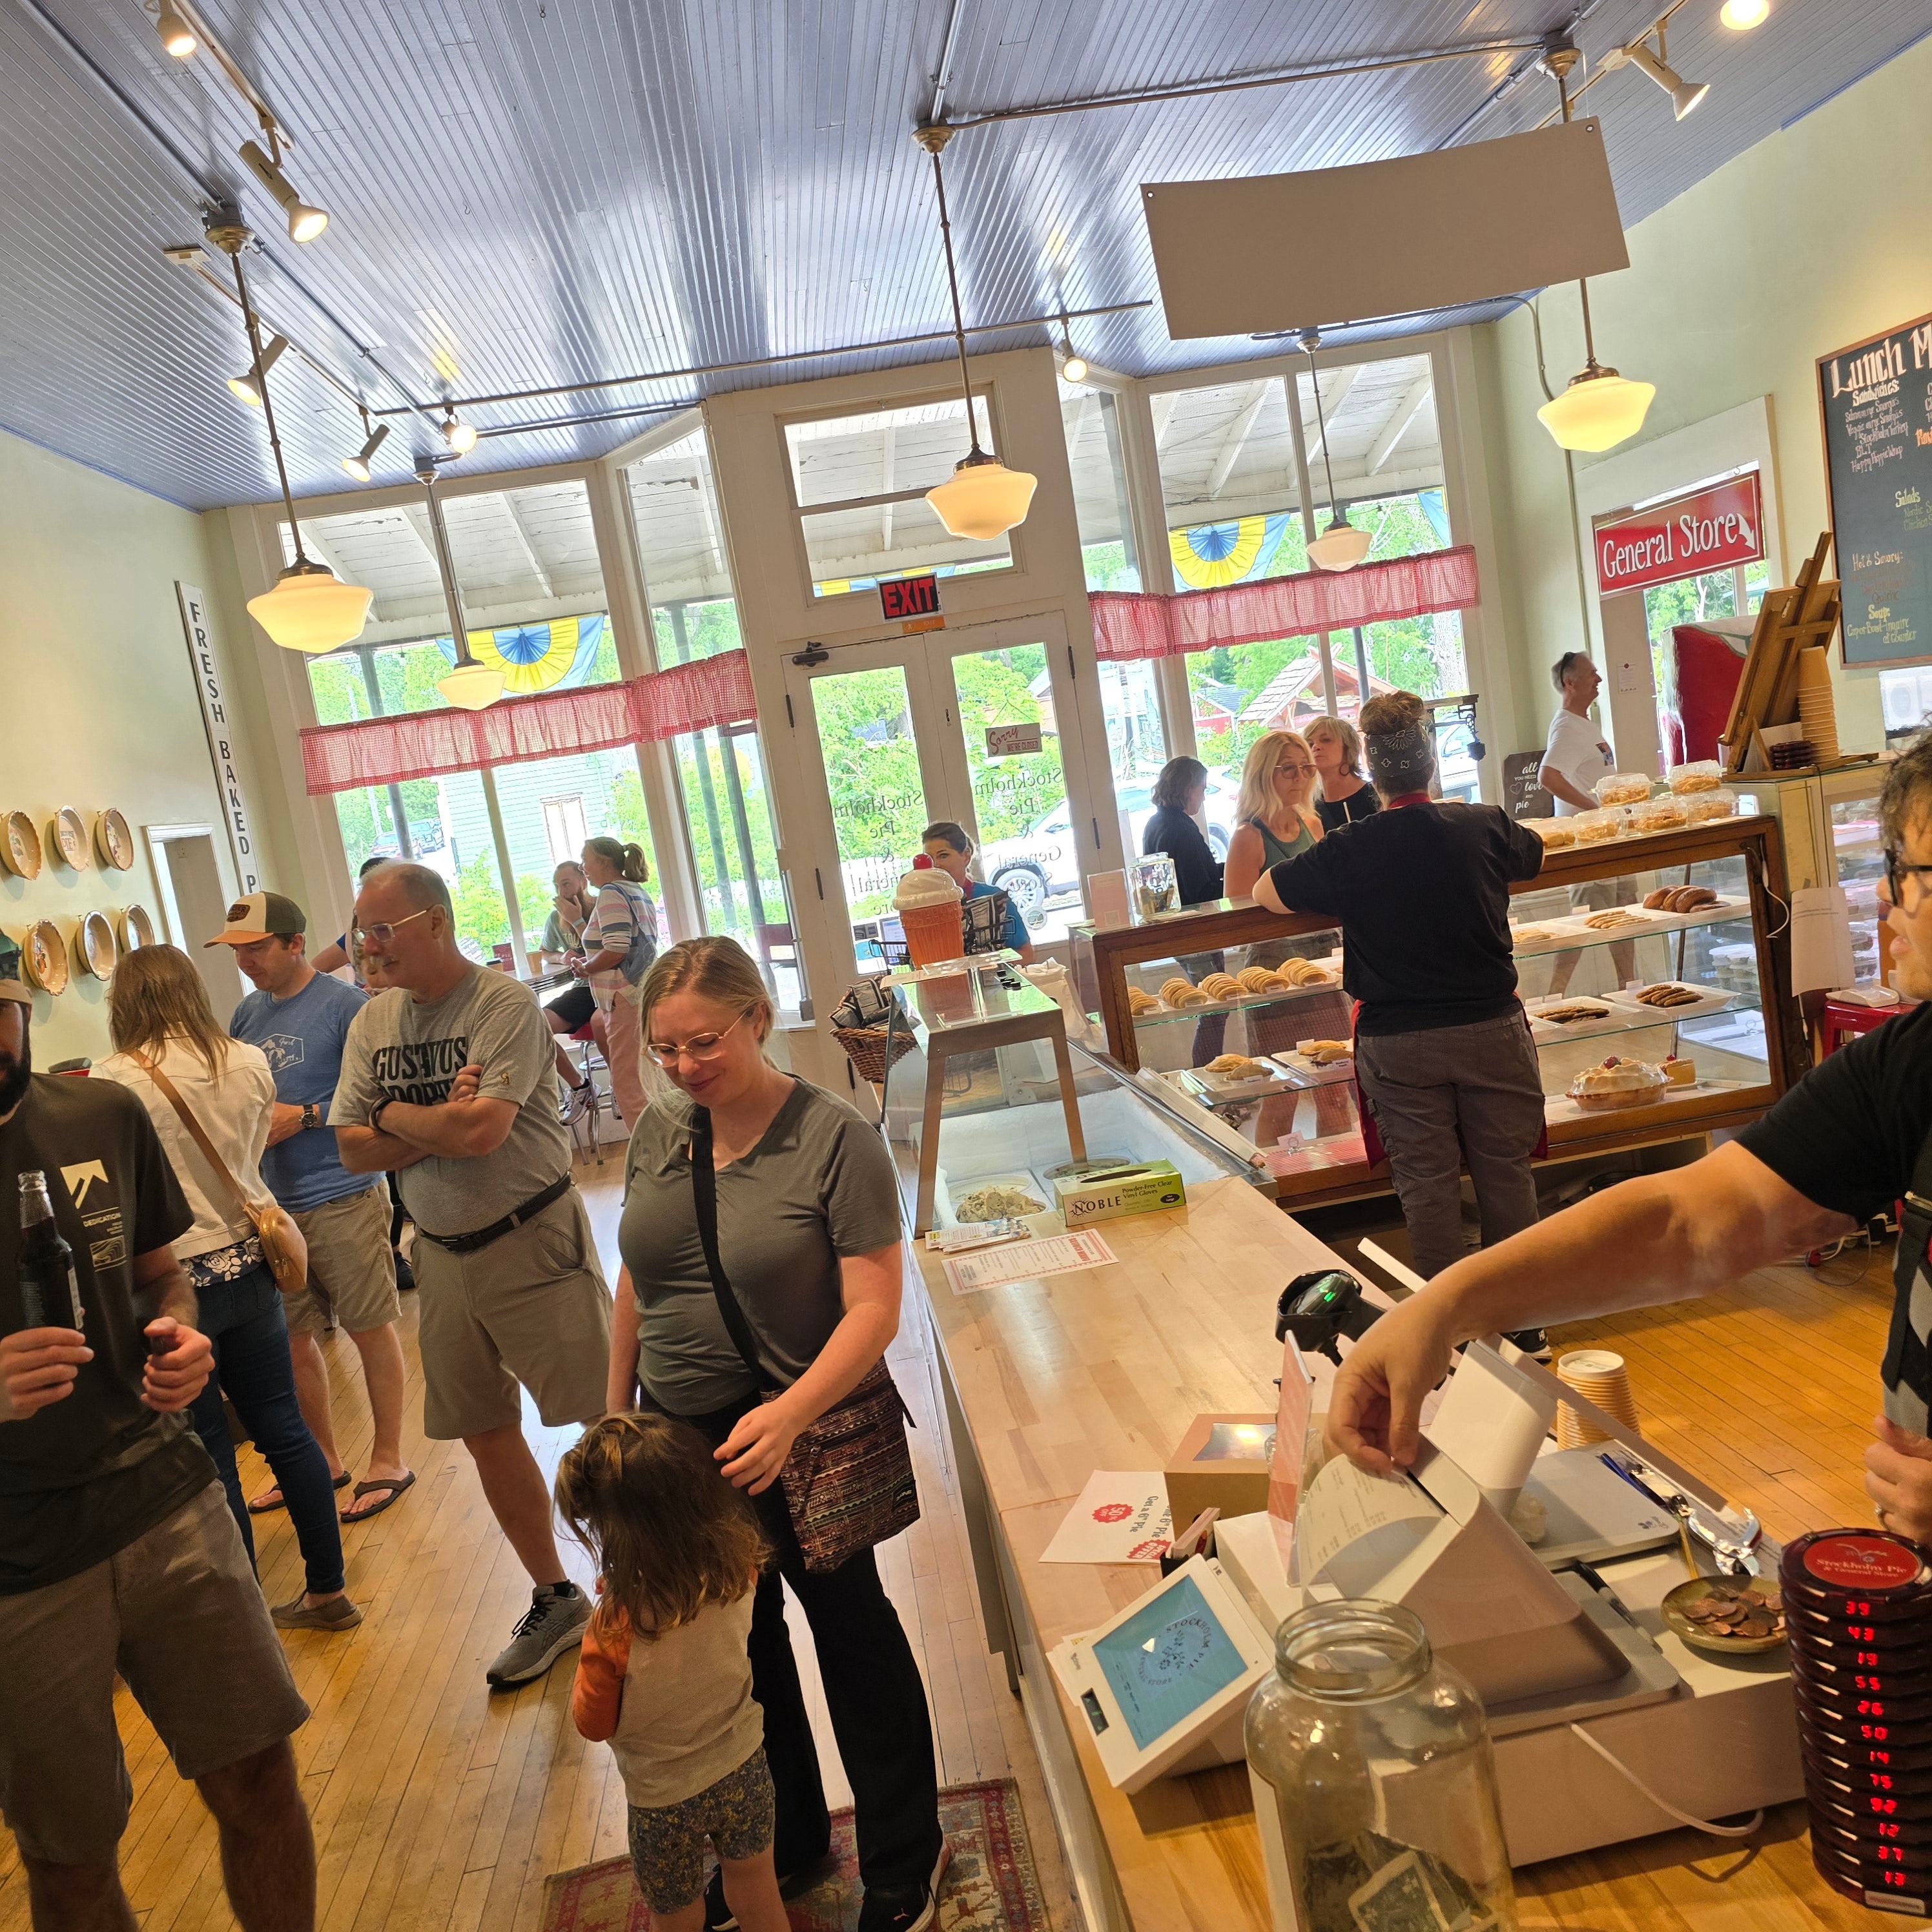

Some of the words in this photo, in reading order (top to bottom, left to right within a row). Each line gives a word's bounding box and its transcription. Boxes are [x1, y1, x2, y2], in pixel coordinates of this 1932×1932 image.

[1829, 338, 1907, 398] Lunch
[1855, 442, 1872, 458] BLT
[1895, 486, 1920, 508] Salads
[1603, 520, 1674, 578] General
[1680, 513, 1738, 557] Store
[1852, 553, 1865, 571] Hot
[882, 578, 934, 617] EXIT
[189, 601, 225, 723] FRESH
[219, 740, 251, 856] BAKED
[989, 727, 1018, 755] Sorry
[1007, 741, 1021, 752] WE'RE
[1022, 739, 1039, 750] CLOSED
[1522, 761, 1538, 774] all
[1516, 800, 1529, 813] pie
[1122, 1184, 1156, 1193] Powder-Free
[1074, 1195, 1121, 1213] NOBLE
[83, 1212, 121, 1227] DEDICATION
[1144, 1495, 1158, 1506] Get
[1099, 1508, 1109, 1517] OFF
[1129, 1522, 1146, 1532] Pie
[1151, 1526, 1167, 1537] Pie
[1816, 1559, 1882, 1571] Stockholm
[1845, 1601, 1870, 1616] 39
[1166, 1618, 1211, 1648] STOCKHOLM
[1848, 1626, 1874, 1641] 43
[1858, 1652, 1878, 1666] 19
[1855, 1675, 1880, 1690] 55
[1857, 1700, 1884, 1716] 26
[1861, 1725, 1888, 1740] 50
[1870, 1751, 1889, 1764] 14
[1879, 1823, 1899, 1837] 12
[1878, 1845, 1904, 1862] 37
[1885, 1871, 1905, 1886] 13
